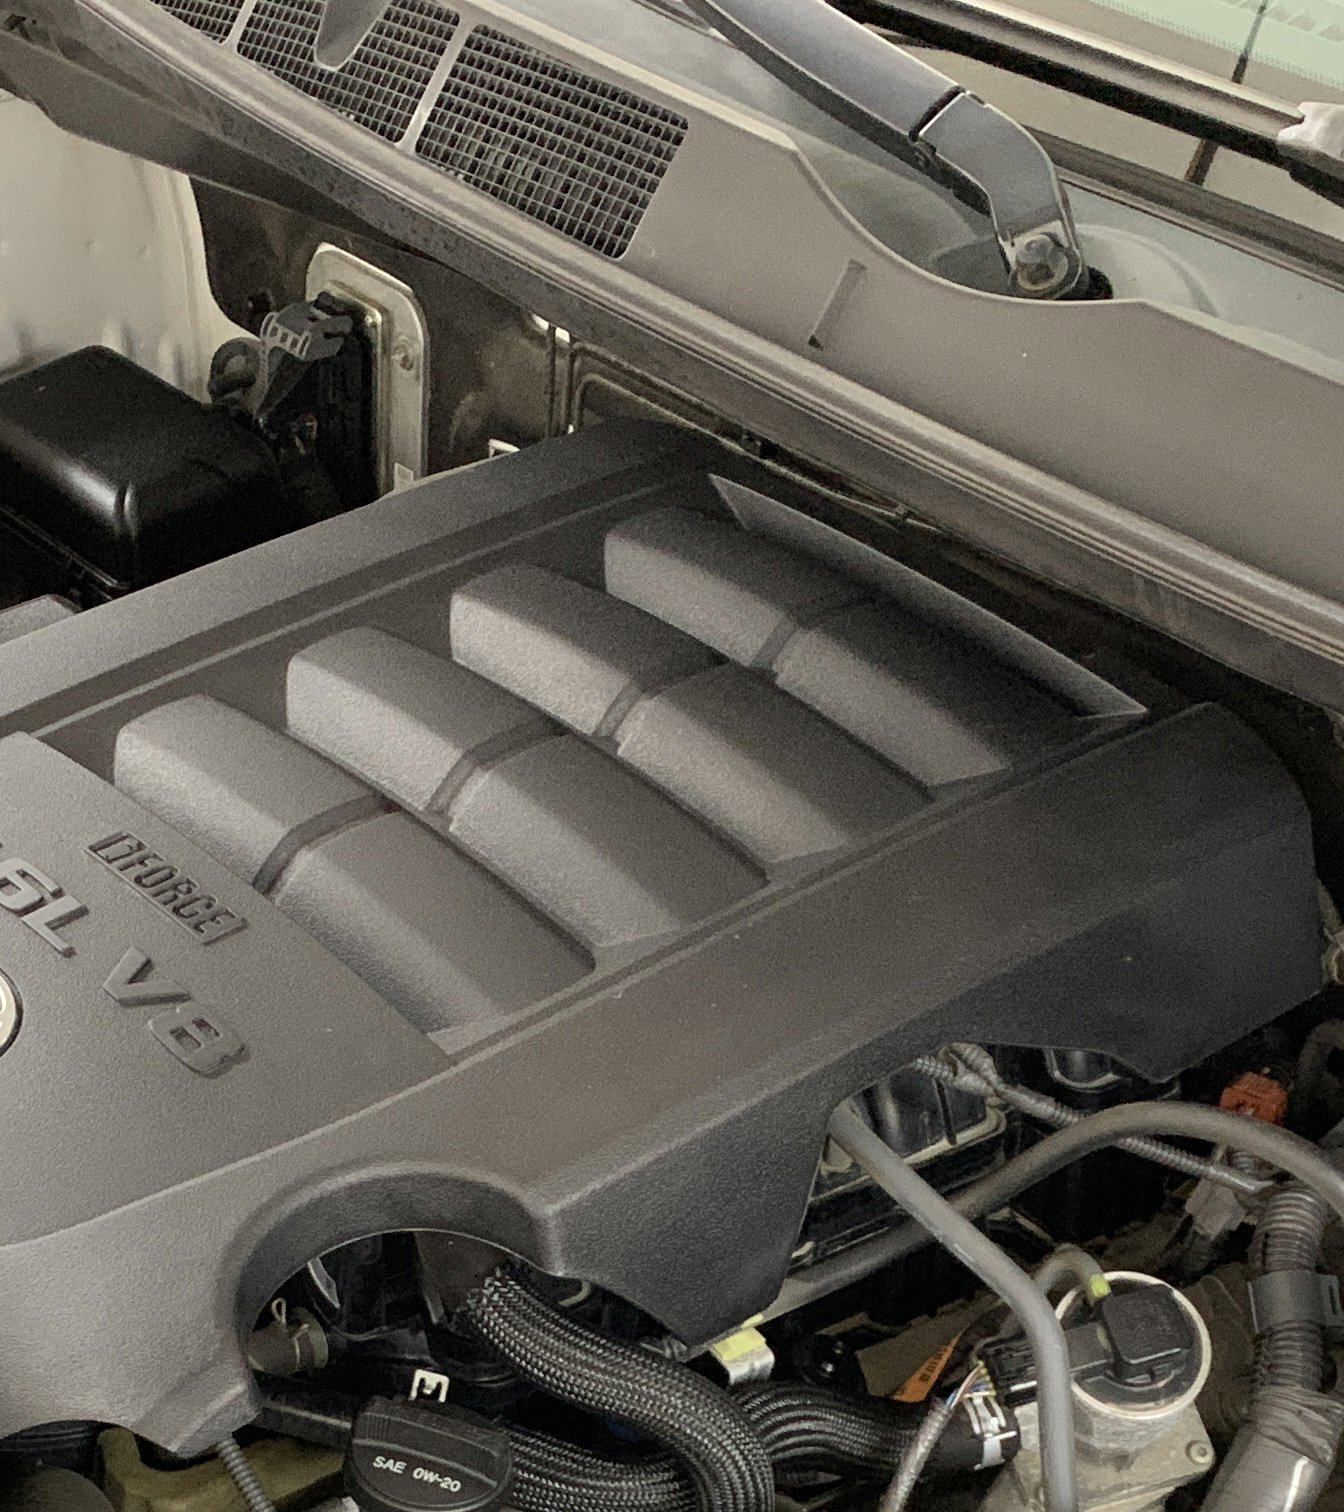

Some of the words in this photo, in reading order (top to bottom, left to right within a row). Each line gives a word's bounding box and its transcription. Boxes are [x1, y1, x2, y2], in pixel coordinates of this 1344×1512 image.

[102, 944, 249, 1077] V8
[372, 1456, 407, 1474] SAE
[413, 1467, 461, 1492] 0W-20
